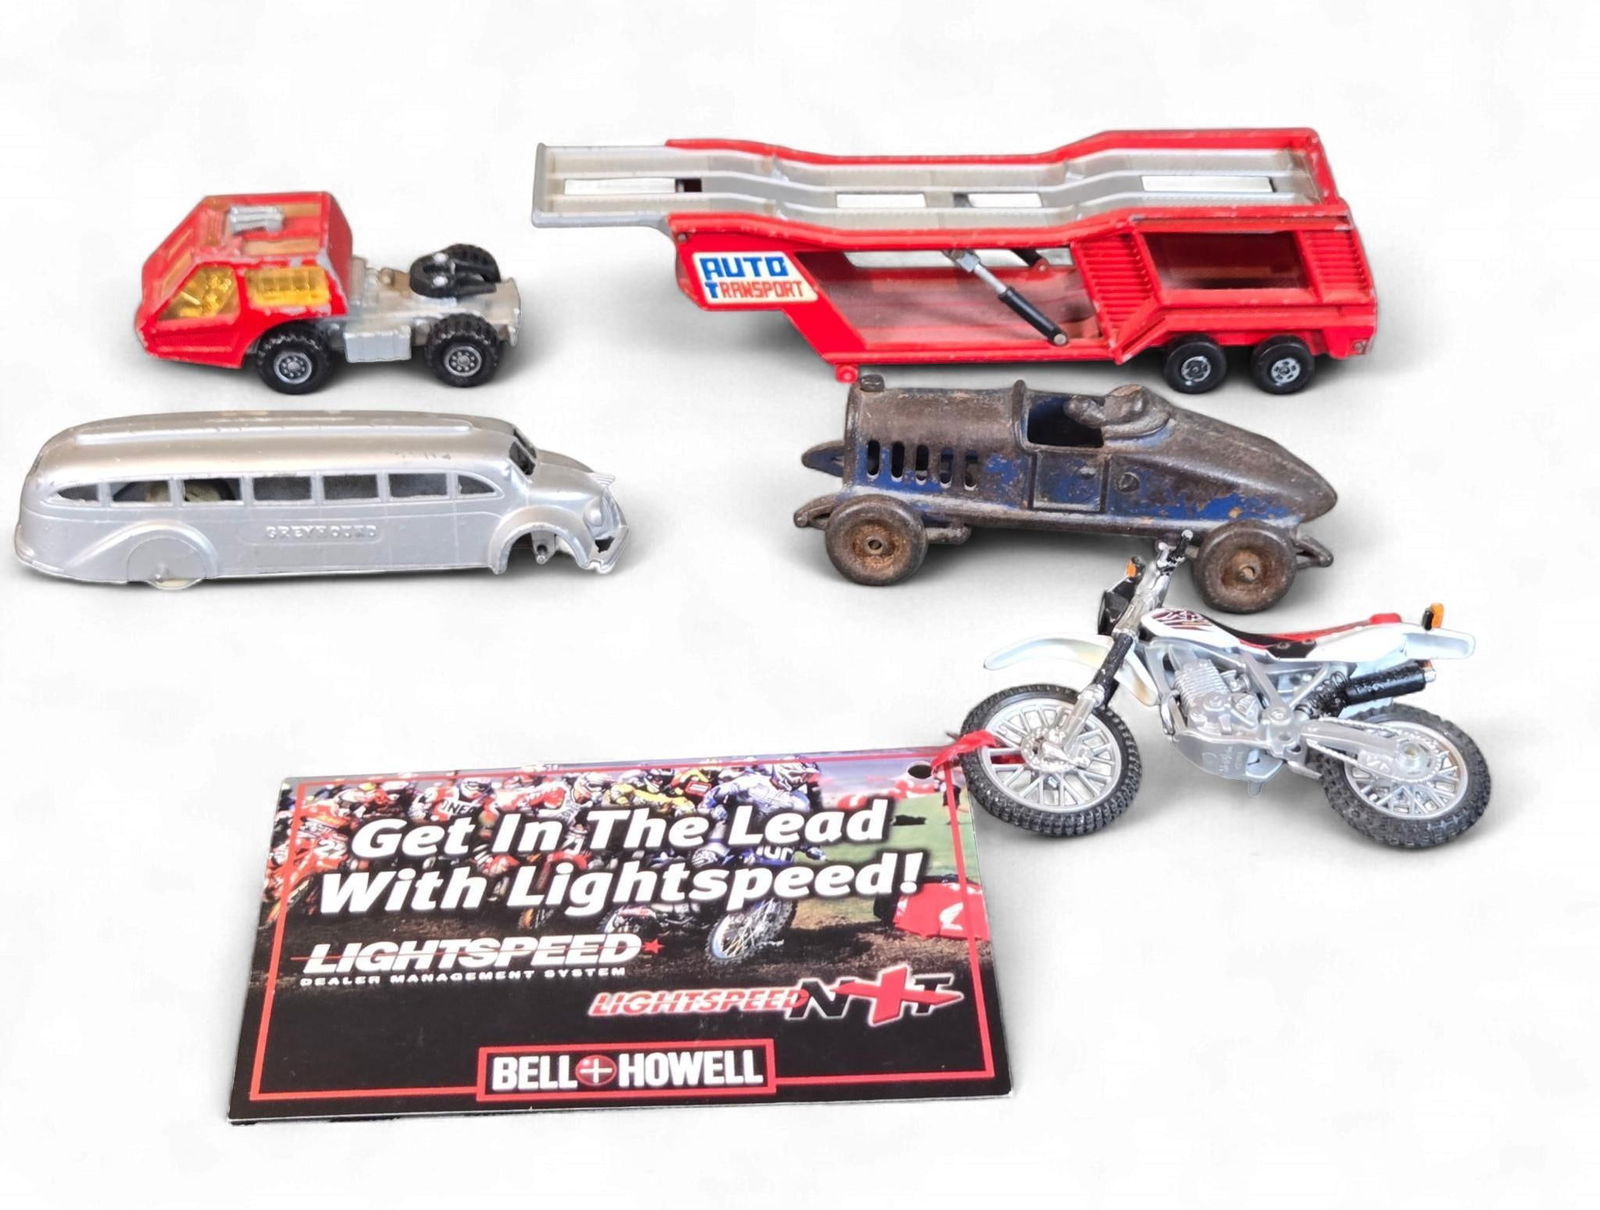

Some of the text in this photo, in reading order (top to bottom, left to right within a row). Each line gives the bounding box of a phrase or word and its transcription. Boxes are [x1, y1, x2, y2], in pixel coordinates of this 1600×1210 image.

[699, 256, 789, 280] AUTO
[704, 281, 804, 299] TRANSPORT
[265, 524, 377, 538] GREYHOUND
[351, 798, 889, 859] Get In The Lead
[320, 852, 924, 918] With Lightspeed!
[302, 932, 643, 974] LIGHTSPEED
[300, 967, 626, 987] DEALER MANAGEMENT SYSTEM
[589, 986, 811, 1016] LIGHTSPEED
[492, 1049, 764, 1092] BELL HOWELL
